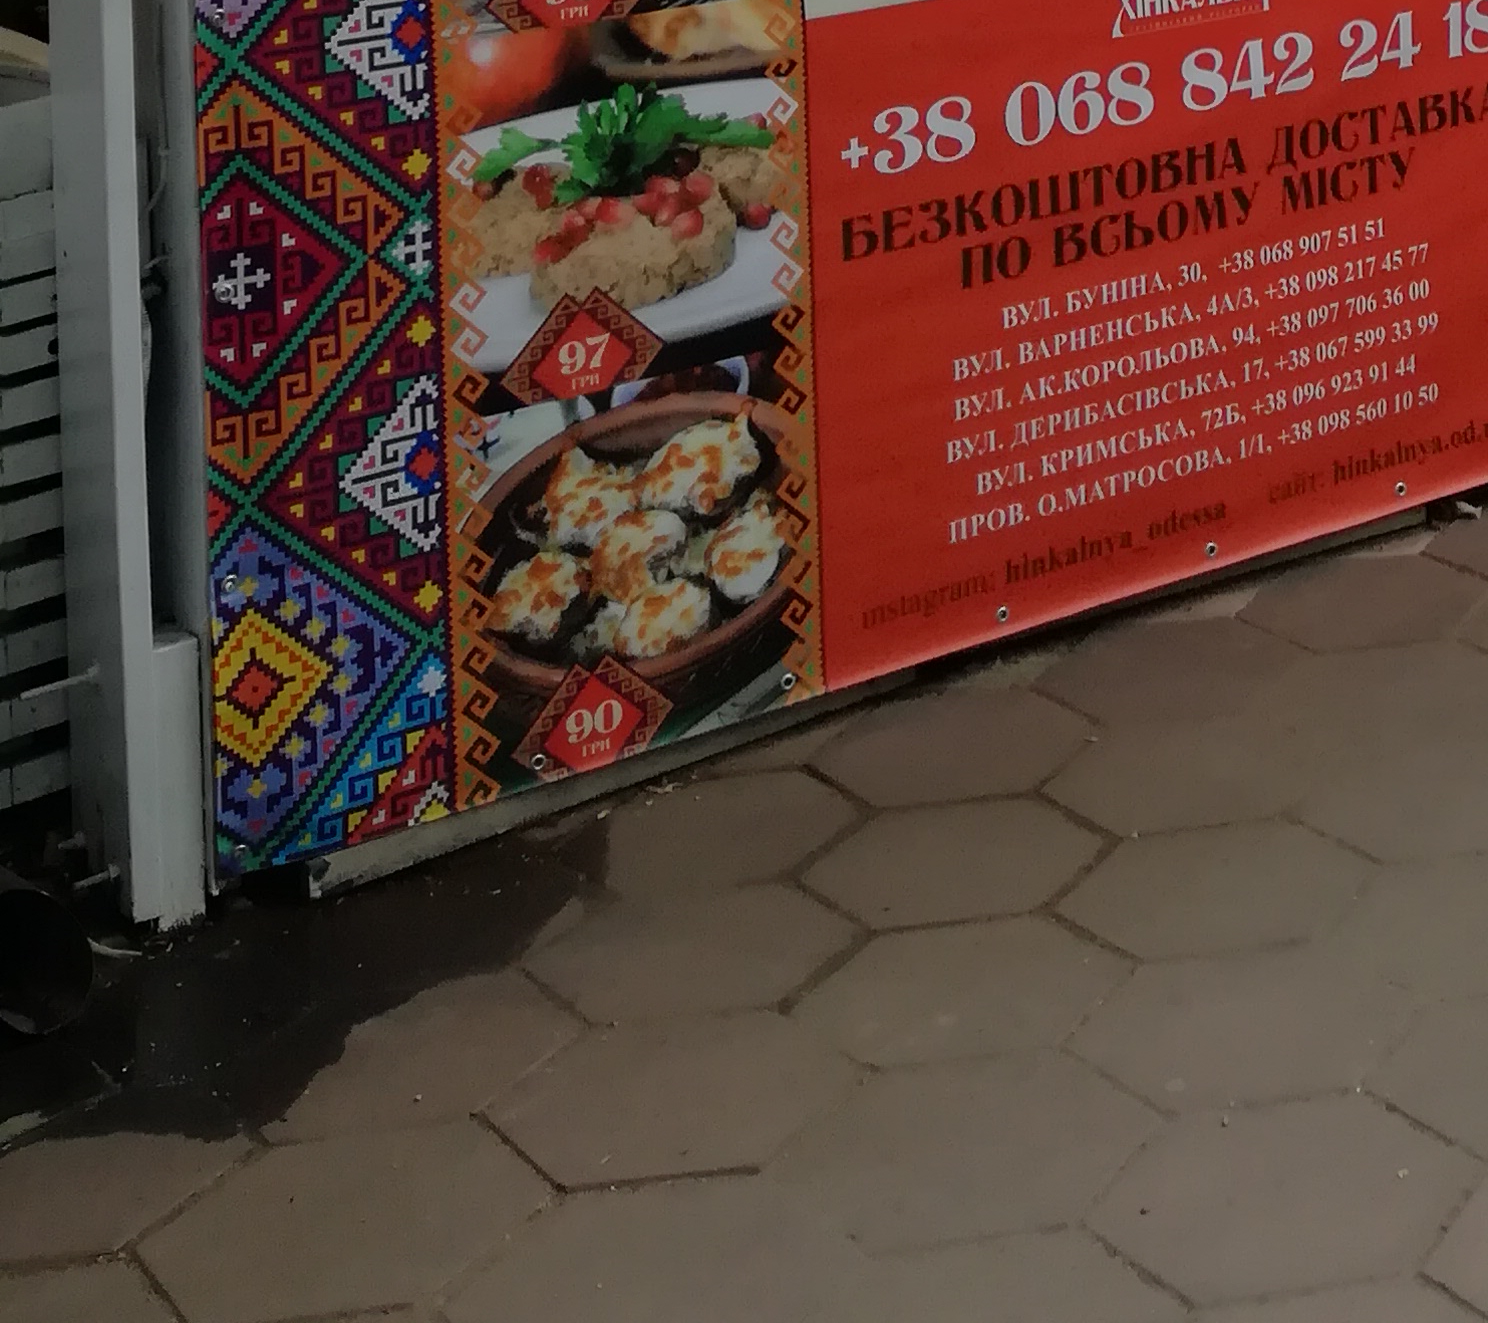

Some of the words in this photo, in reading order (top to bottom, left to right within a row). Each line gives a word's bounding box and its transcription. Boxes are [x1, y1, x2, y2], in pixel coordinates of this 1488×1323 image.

[841, 97, 975, 173] +38
[1005, 62, 1154, 145] 068
[1182, 32, 1313, 110] 842
[1340, 11, 1421, 81] 24
[841, 136, 1247, 260] БЕЗКОШТОВНА
[962, 237, 1030, 289] ПО
[1053, 185, 1260, 268] ВСЬОМУ
[1281, 148, 1415, 213] МІСТУ
[1002, 297, 1058, 329] ВУЛ.
[1066, 272, 1172, 313] БУНІНА,
[1178, 262, 1207, 286] 30,
[1219, 249, 1253, 273] +38
[1260, 240, 1293, 265] 068
[1299, 230, 1331, 255] 907
[1338, 224, 1356, 247] 51
[1365, 218, 1384, 240] 51
[558, 333, 610, 374] 97
[566, 699, 622, 743] 90
